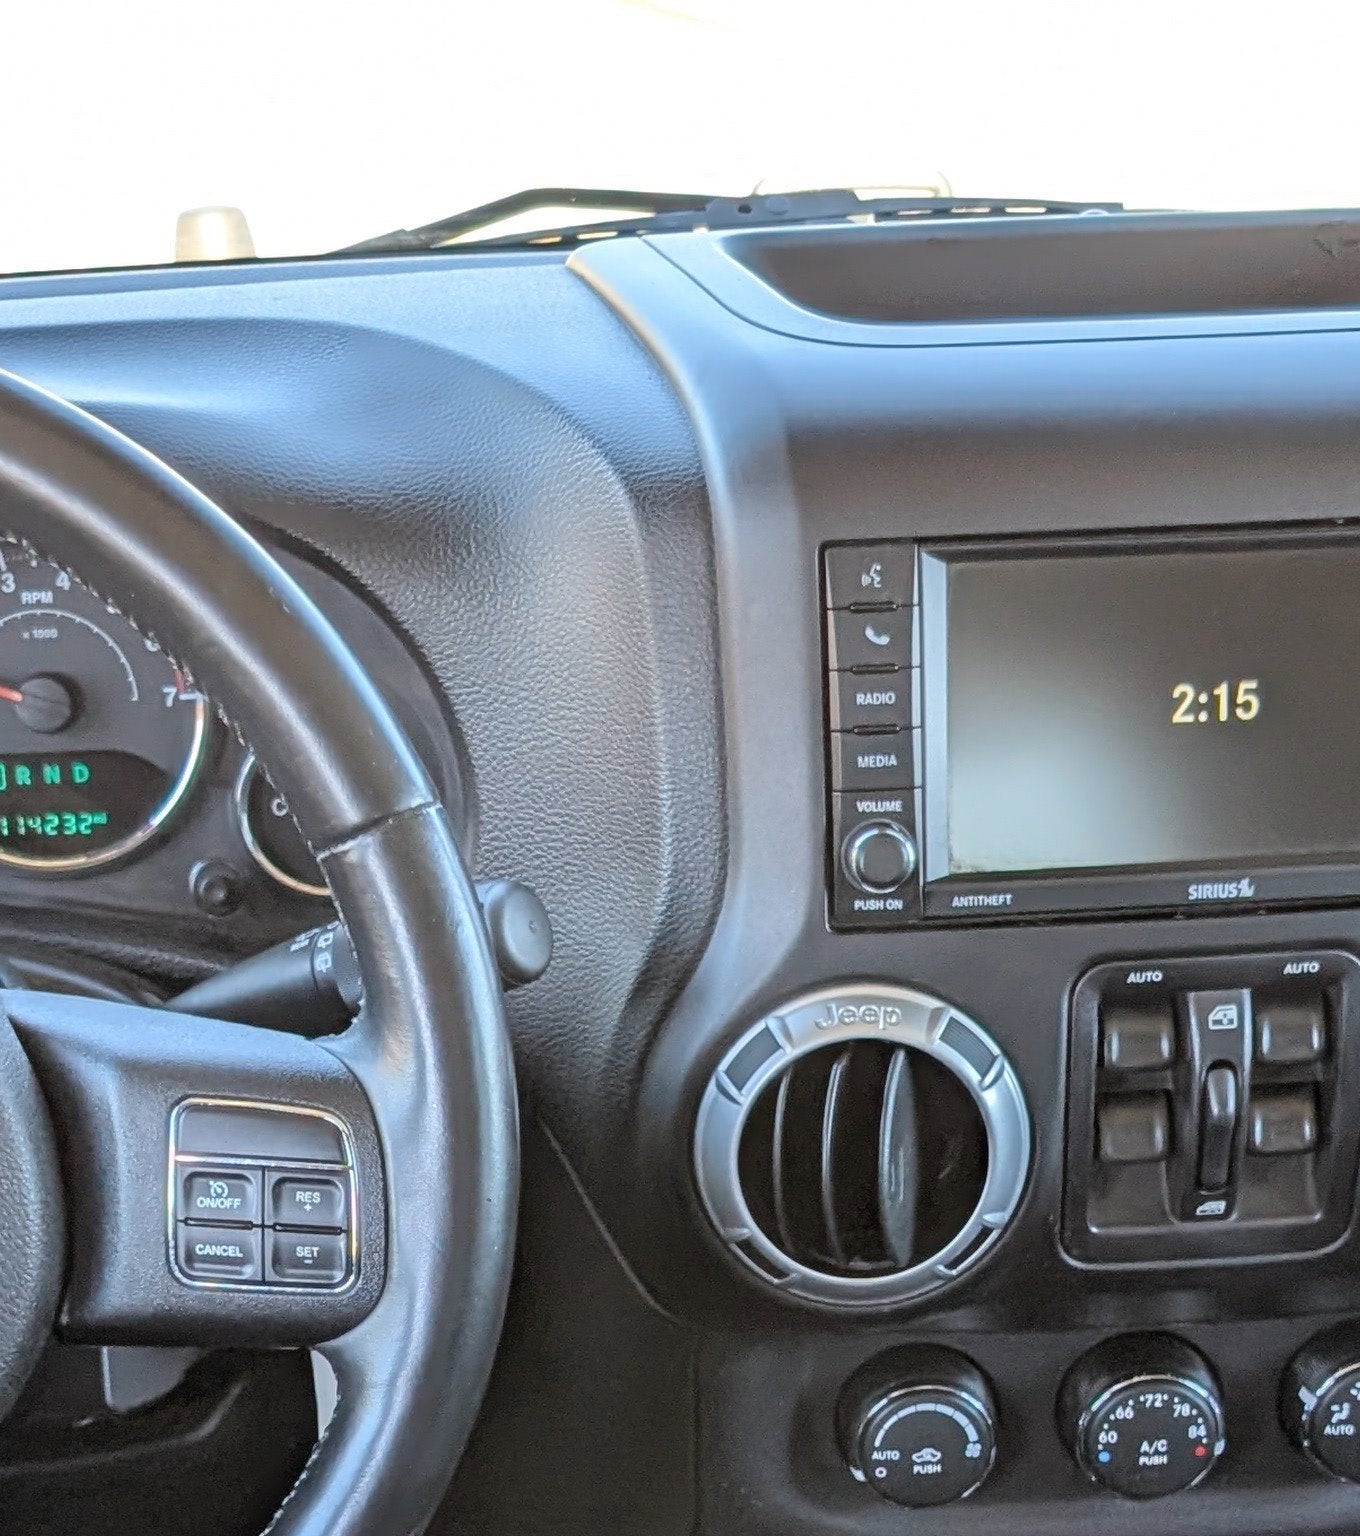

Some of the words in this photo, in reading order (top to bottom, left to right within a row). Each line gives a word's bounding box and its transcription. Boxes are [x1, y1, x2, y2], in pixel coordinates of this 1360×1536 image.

[1, 572, 16, 592] 3
[55, 571, 70, 591] 4
[20, 591, 53, 604] RPM
[162, 686, 177, 708] 7
[856, 692, 895, 707] RADIO
[1171, 679, 1261, 724] 2:15
[857, 755, 897, 769] MEDIA
[15, 764, 32, 785] R
[43, 763, 60, 784] N
[72, 762, 89, 783] D
[856, 800, 903, 814] VOLUME
[1188, 883, 1238, 901] SIRIUS
[854, 899, 883, 912] PUSH
[885, 898, 903, 911] ON
[952, 893, 1013, 908] ANTITHEFT
[1283, 961, 1320, 976] AUTO
[1126, 970, 1164, 984] AUTO
[815, 1003, 903, 1031] Jeep
[196, 1197, 242, 1210] ON/OFF
[296, 1191, 321, 1203] RES
[195, 1244, 243, 1258] CANCEL
[296, 1246, 320, 1258] SET
[1115, 1406, 1134, 1420] 66
[1098, 1430, 1118, 1444] 60
[1324, 1425, 1355, 1436] AUTO
[871, 1450, 900, 1462] AUTO
[913, 1464, 942, 1476] PUSH
